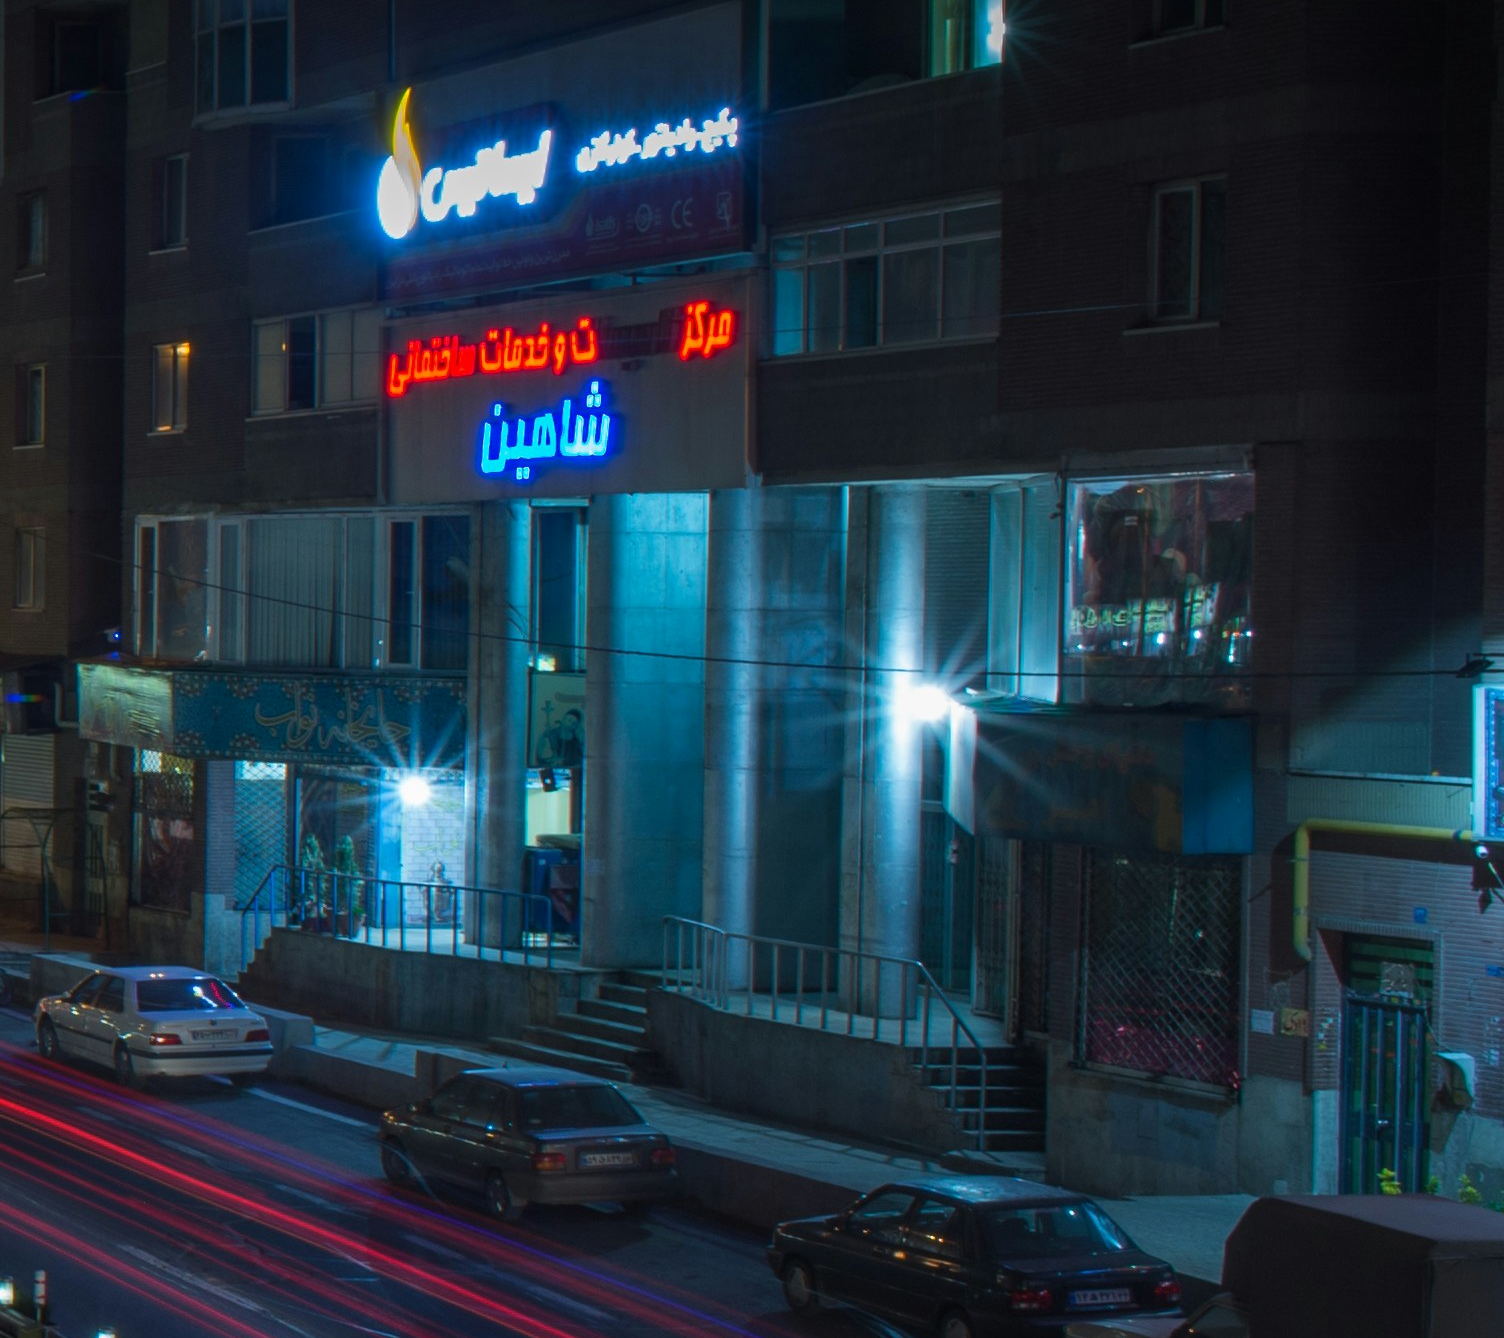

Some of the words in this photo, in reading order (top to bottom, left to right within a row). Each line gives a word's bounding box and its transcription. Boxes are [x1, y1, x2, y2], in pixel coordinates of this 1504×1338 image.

[479, 322, 550, 374] خدمات
[552, 330, 568, 376] و
[680, 300, 736, 361] مرکز
[387, 334, 477, 398] ساختمانی
[480, 380, 612, 481] شاهین
